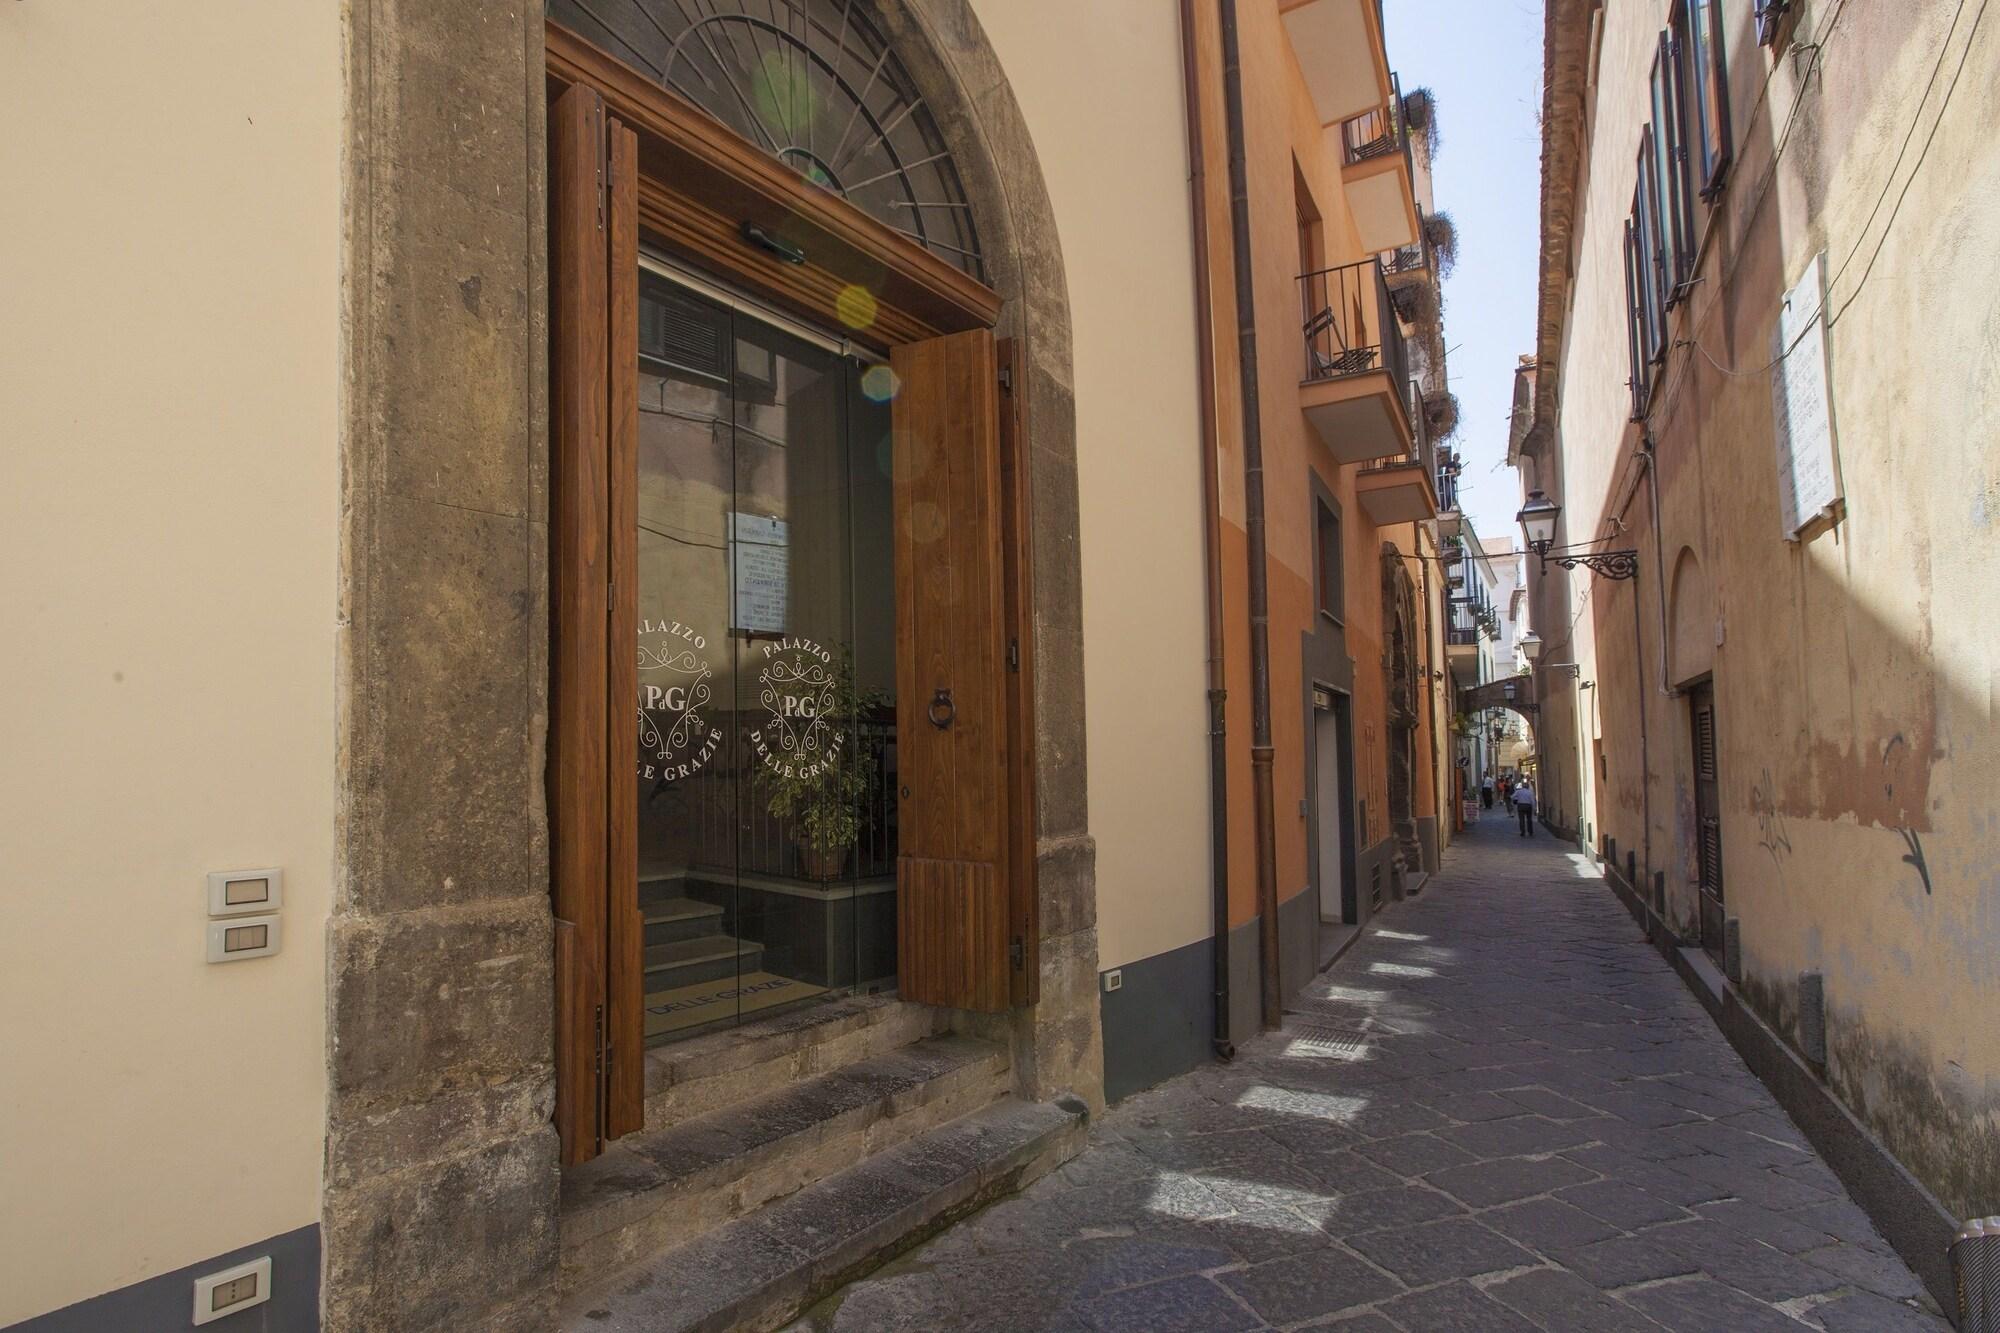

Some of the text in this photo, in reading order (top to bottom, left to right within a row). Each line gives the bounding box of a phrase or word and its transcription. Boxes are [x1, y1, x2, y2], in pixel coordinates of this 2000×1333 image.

[762, 637, 831, 664] PALAZZO
[645, 685, 687, 711] PdG
[784, 695, 817, 718] PdG
[663, 728, 722, 781] GRAZIE
[750, 730, 844, 779] DELLE GRAZIE
